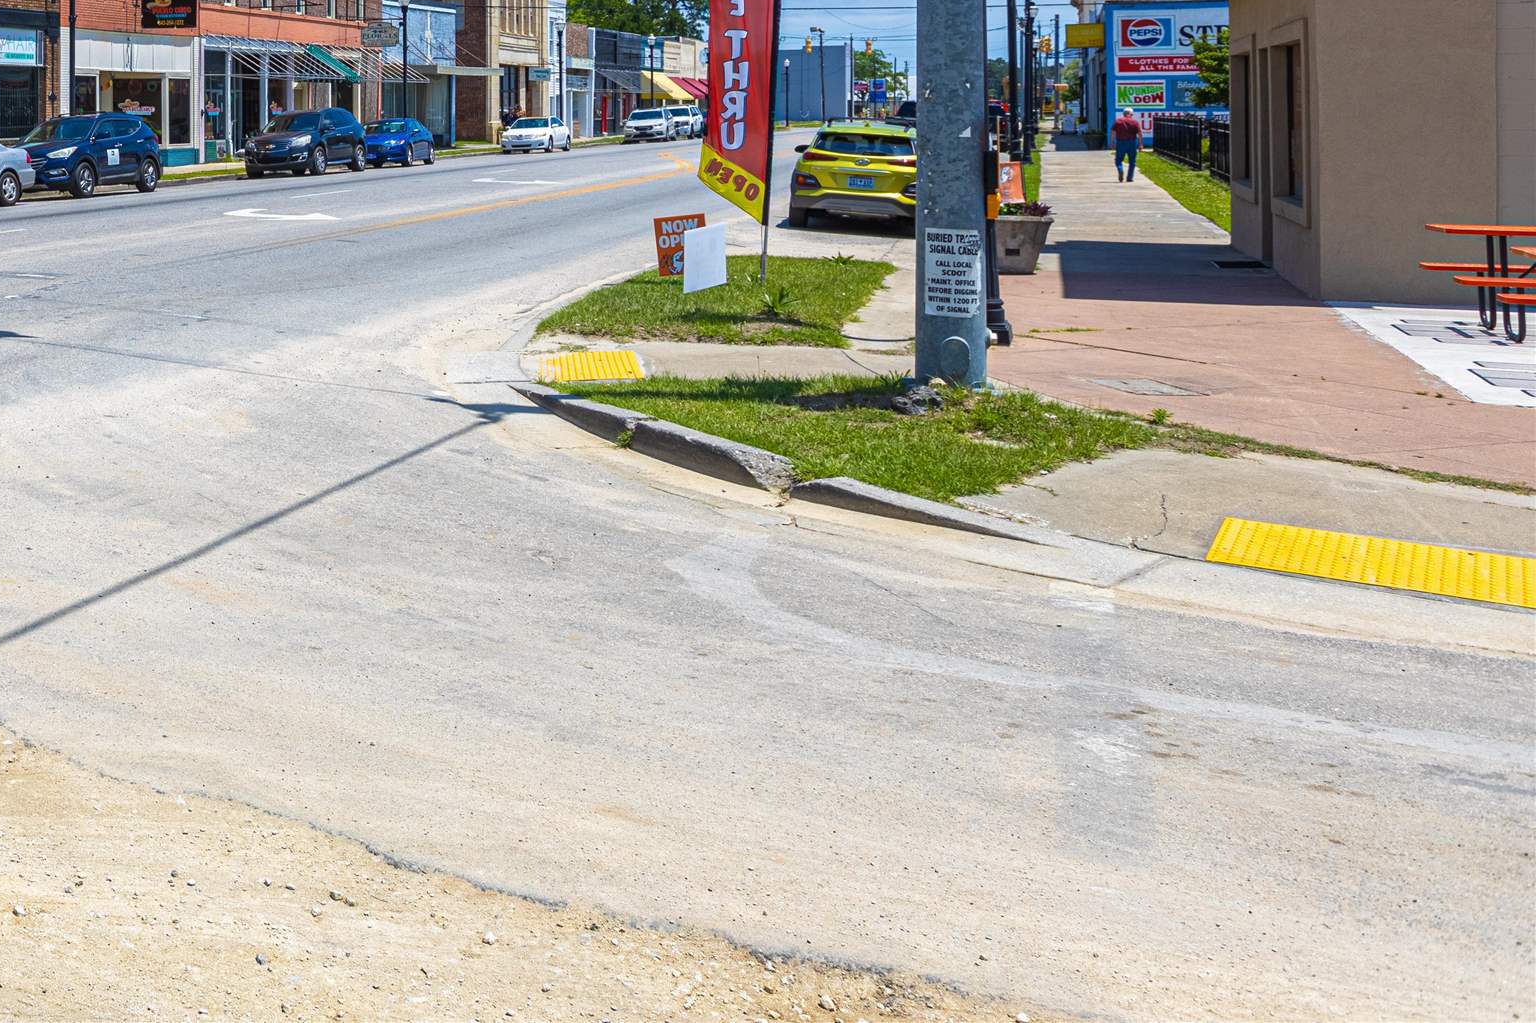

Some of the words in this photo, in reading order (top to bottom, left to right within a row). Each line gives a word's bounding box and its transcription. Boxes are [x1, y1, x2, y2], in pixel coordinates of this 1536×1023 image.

[1129, 28, 1162, 37] PEPSI
[661, 218, 699, 234] NOW
[927, 232, 953, 243] BURIED
[929, 244, 956, 255] SIGNAL
[935, 260, 951, 268] CALL
[941, 269, 967, 277] SCDOT
[930, 278, 953, 286] MAINT.
[954, 279, 976, 287] OFFICE
[927, 286, 953, 295] BEFORE
[927, 295, 951, 304] WITHIN
[953, 297, 970, 305] 1200
[946, 305, 970, 314] SIGNAL
